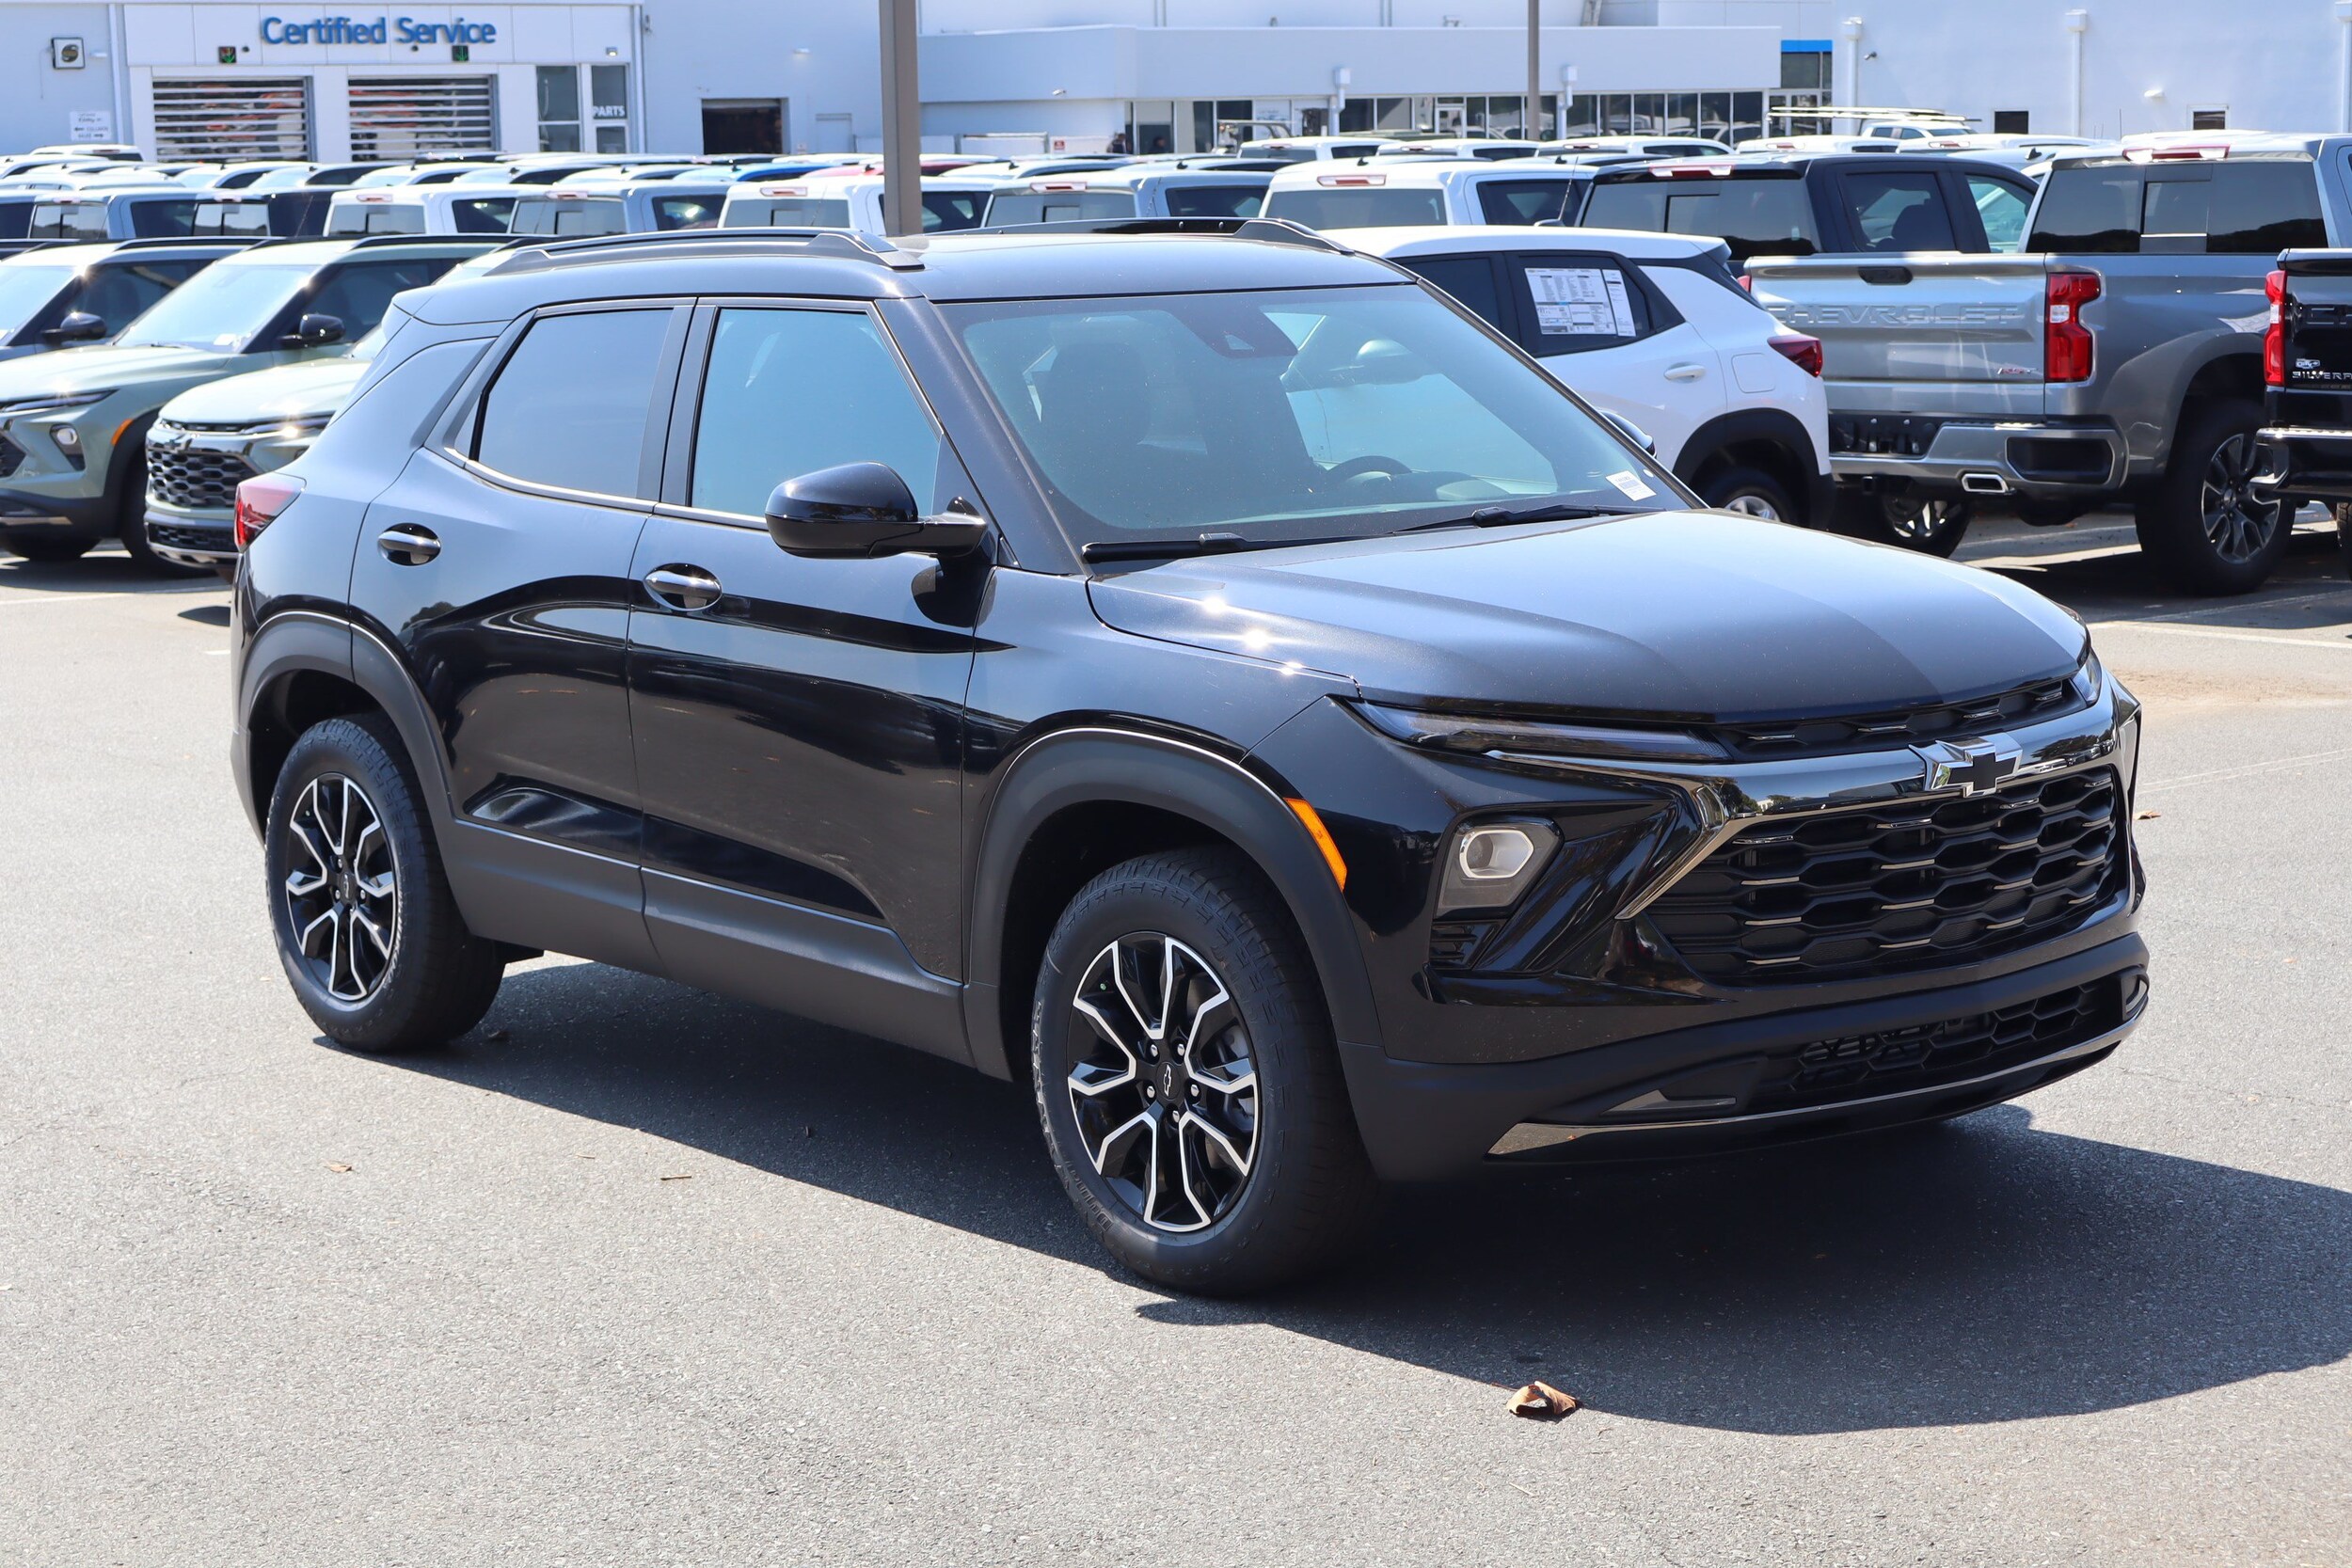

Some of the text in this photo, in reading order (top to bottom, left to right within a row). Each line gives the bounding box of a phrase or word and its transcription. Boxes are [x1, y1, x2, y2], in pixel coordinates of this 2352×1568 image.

[262, 16, 497, 44] Certified Service
[593, 104, 626, 118] PARTS
[1766, 305, 2019, 325] CHEVROLET
